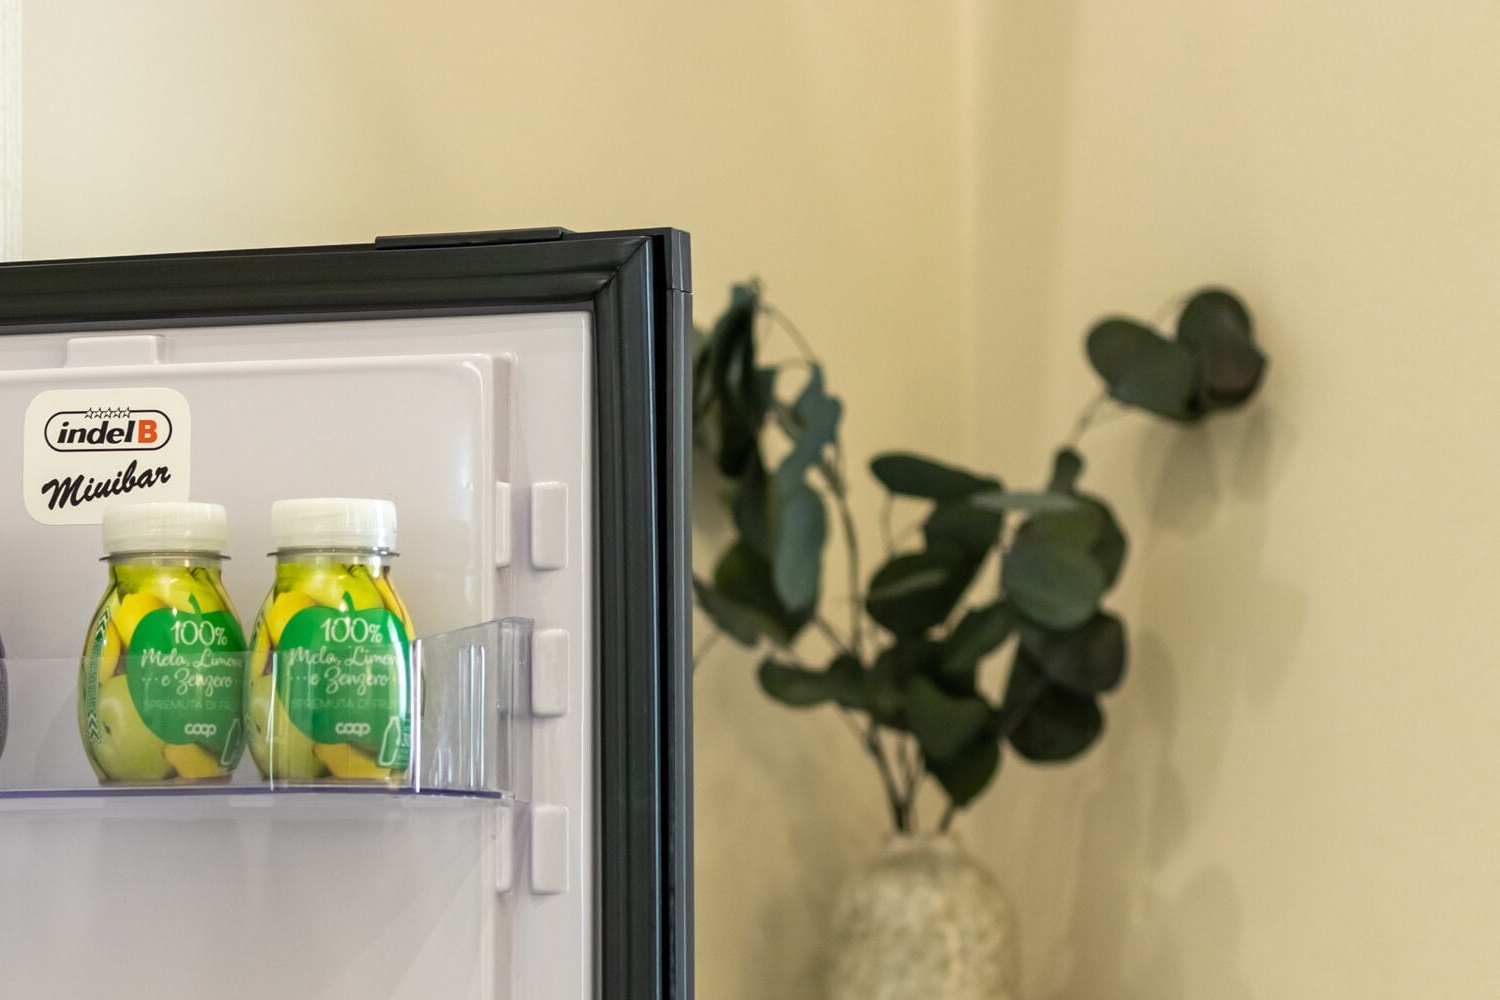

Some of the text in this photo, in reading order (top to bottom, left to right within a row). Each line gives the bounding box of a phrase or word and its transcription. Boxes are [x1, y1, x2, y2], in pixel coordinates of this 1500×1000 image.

[41, 459, 172, 511] Minibar
[171, 620, 228, 646] 100%
[320, 617, 383, 643] 100%
[174, 667, 233, 697] Zenzero
[324, 667, 389, 696] Zenzero
[184, 723, 217, 738] coop
[335, 722, 371, 737] coop
